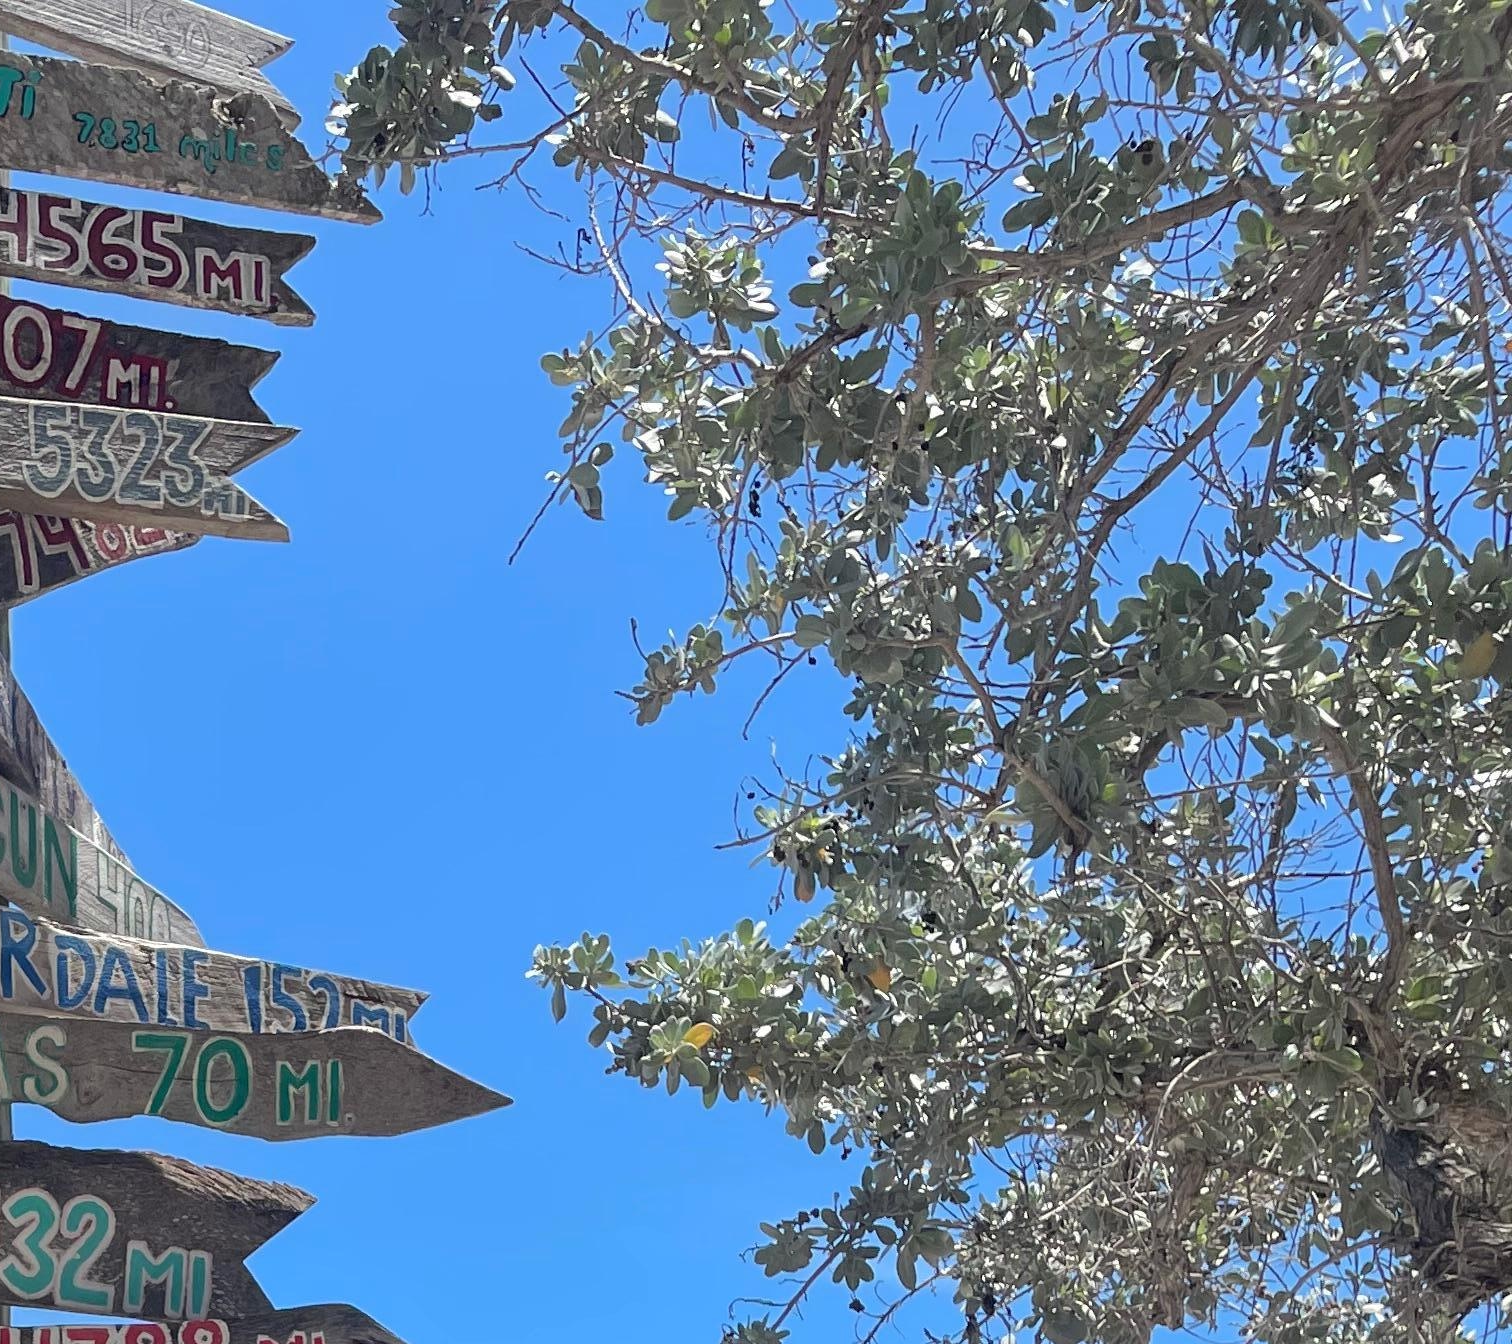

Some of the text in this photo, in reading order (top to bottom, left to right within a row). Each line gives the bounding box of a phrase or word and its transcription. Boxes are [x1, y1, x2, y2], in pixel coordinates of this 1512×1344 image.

[74, 112, 160, 154] 7831
[22, 400, 216, 509] 5323
[349, 999, 407, 1043] MI
[131, 1031, 254, 1125] 70
[122, 1240, 213, 1321] MI
